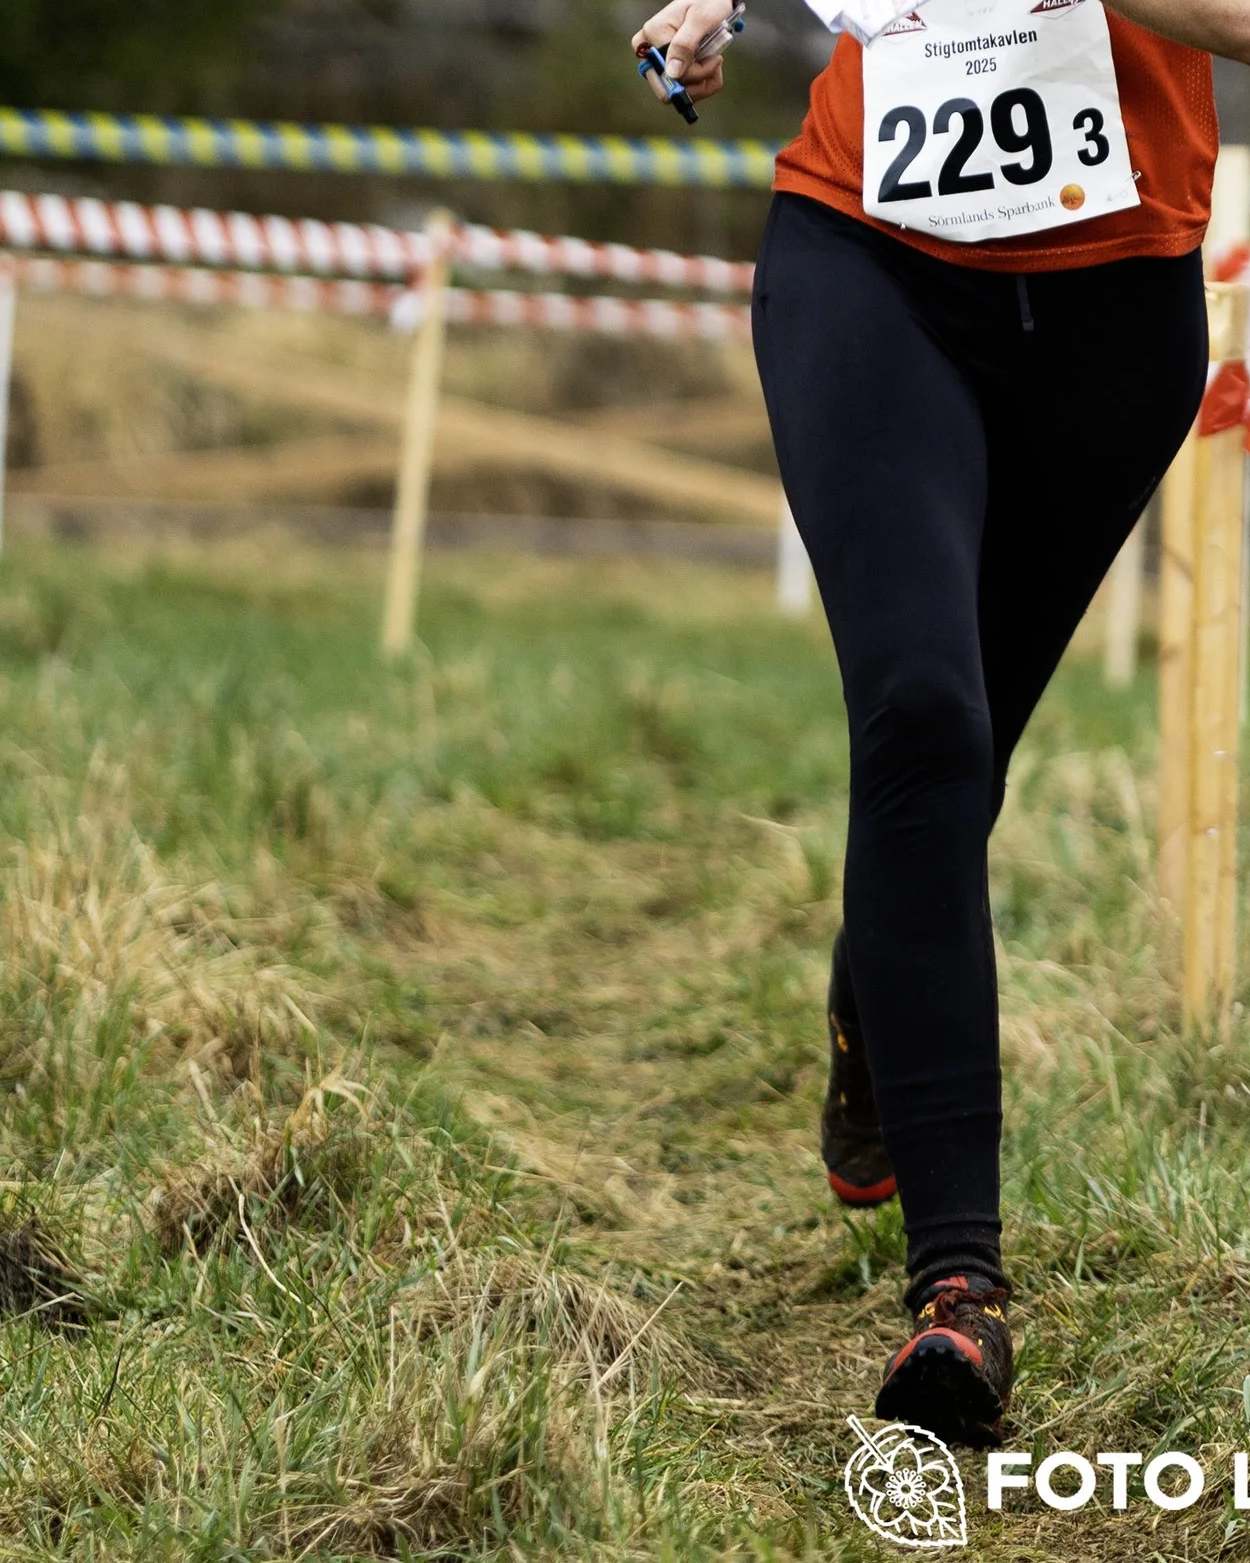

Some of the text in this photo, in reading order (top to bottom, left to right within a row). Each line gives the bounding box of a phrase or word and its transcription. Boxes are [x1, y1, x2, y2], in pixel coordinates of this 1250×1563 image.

[924, 30, 1038, 59] Stigtomtakavlen
[965, 57, 998, 76] 2025
[878, 87, 1110, 203] 229 3
[928, 196, 1056, 228] Sörmlands Sparbank
